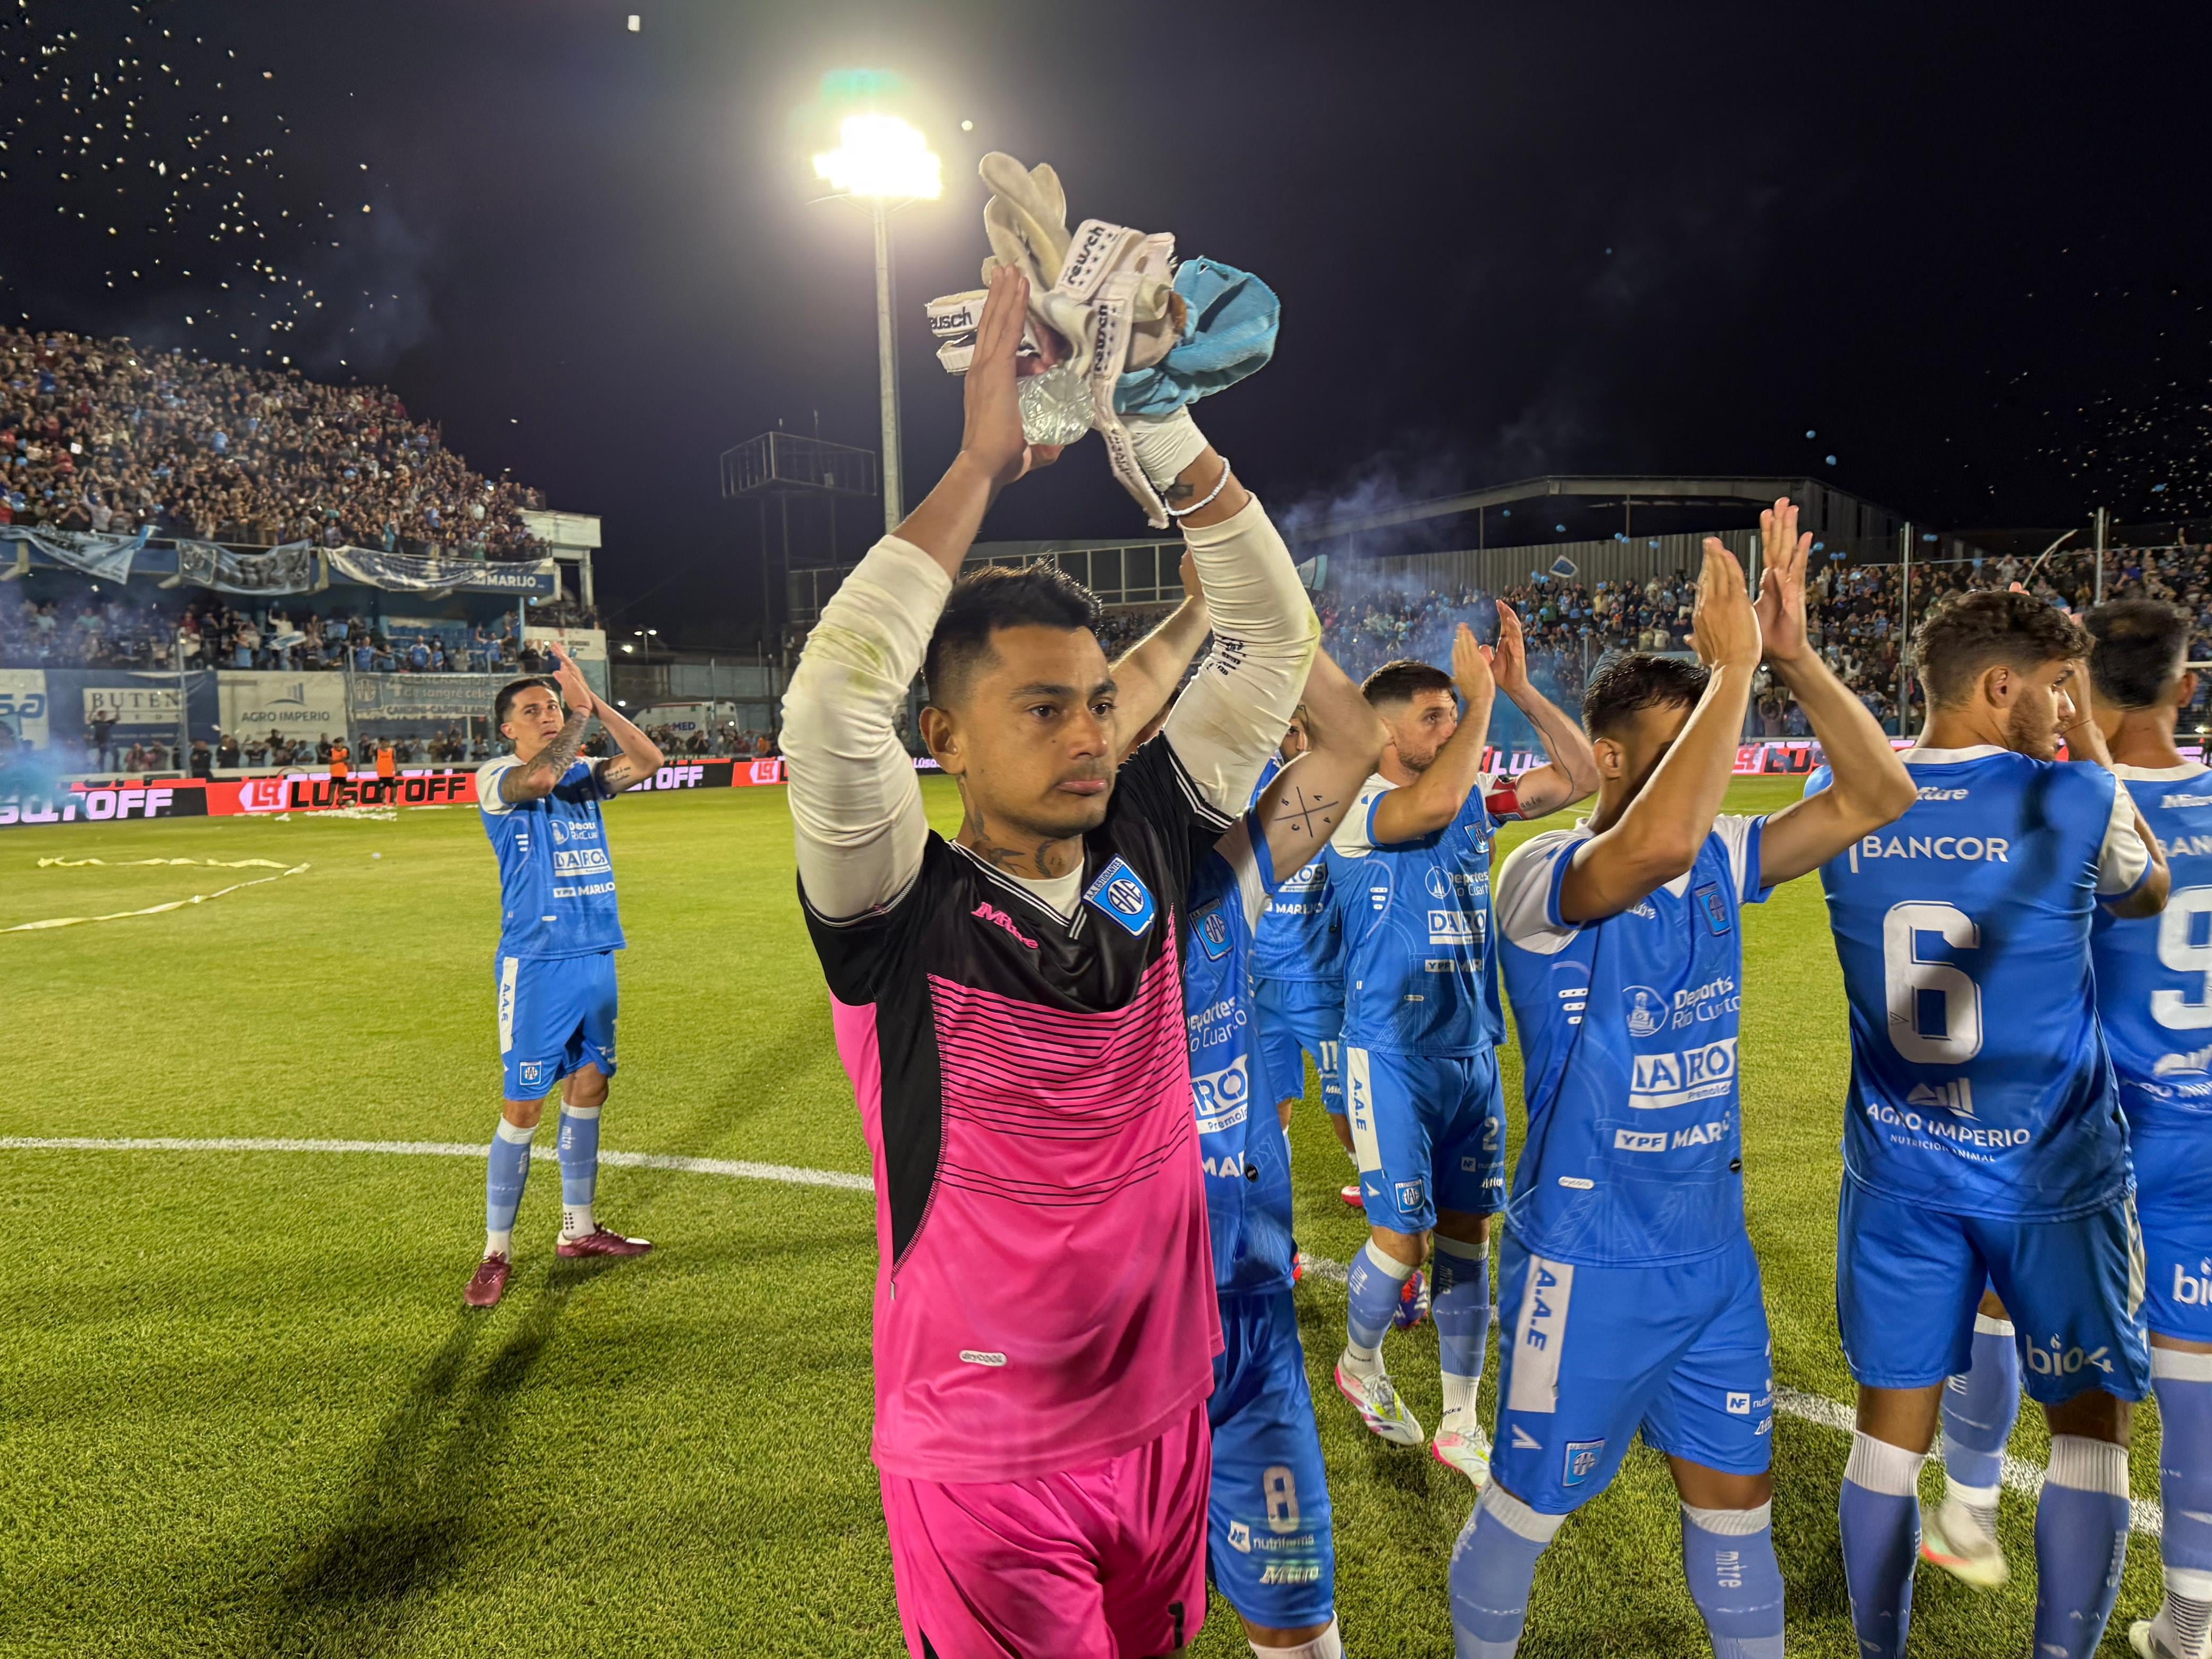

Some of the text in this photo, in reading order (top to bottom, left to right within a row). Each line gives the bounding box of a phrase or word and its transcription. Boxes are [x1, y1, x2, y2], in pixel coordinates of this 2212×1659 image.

[1068, 226, 1105, 284] reusch
[928, 306, 973, 329] eusch
[487, 575, 536, 588] MARIJO
[241, 711, 330, 722] AGRO IMPERIO
[1863, 835, 2009, 863] BANCOR
[1468, 884, 1488, 896] Cuart
[1430, 912, 1485, 932] DARO
[2151, 885, 2212, 1030] 9
[1883, 900, 1983, 1064] 6
[1319, 1041, 1338, 1070] 11
[1482, 1116, 1499, 1151] 2
[1622, 1134, 1663, 1147] YPF
[1928, 1119, 2031, 1148] IMPERIO
[2026, 1333, 2114, 1377] bio4
[1263, 1465, 1300, 1534] 8
[1715, 1549, 1748, 1588] mitre
